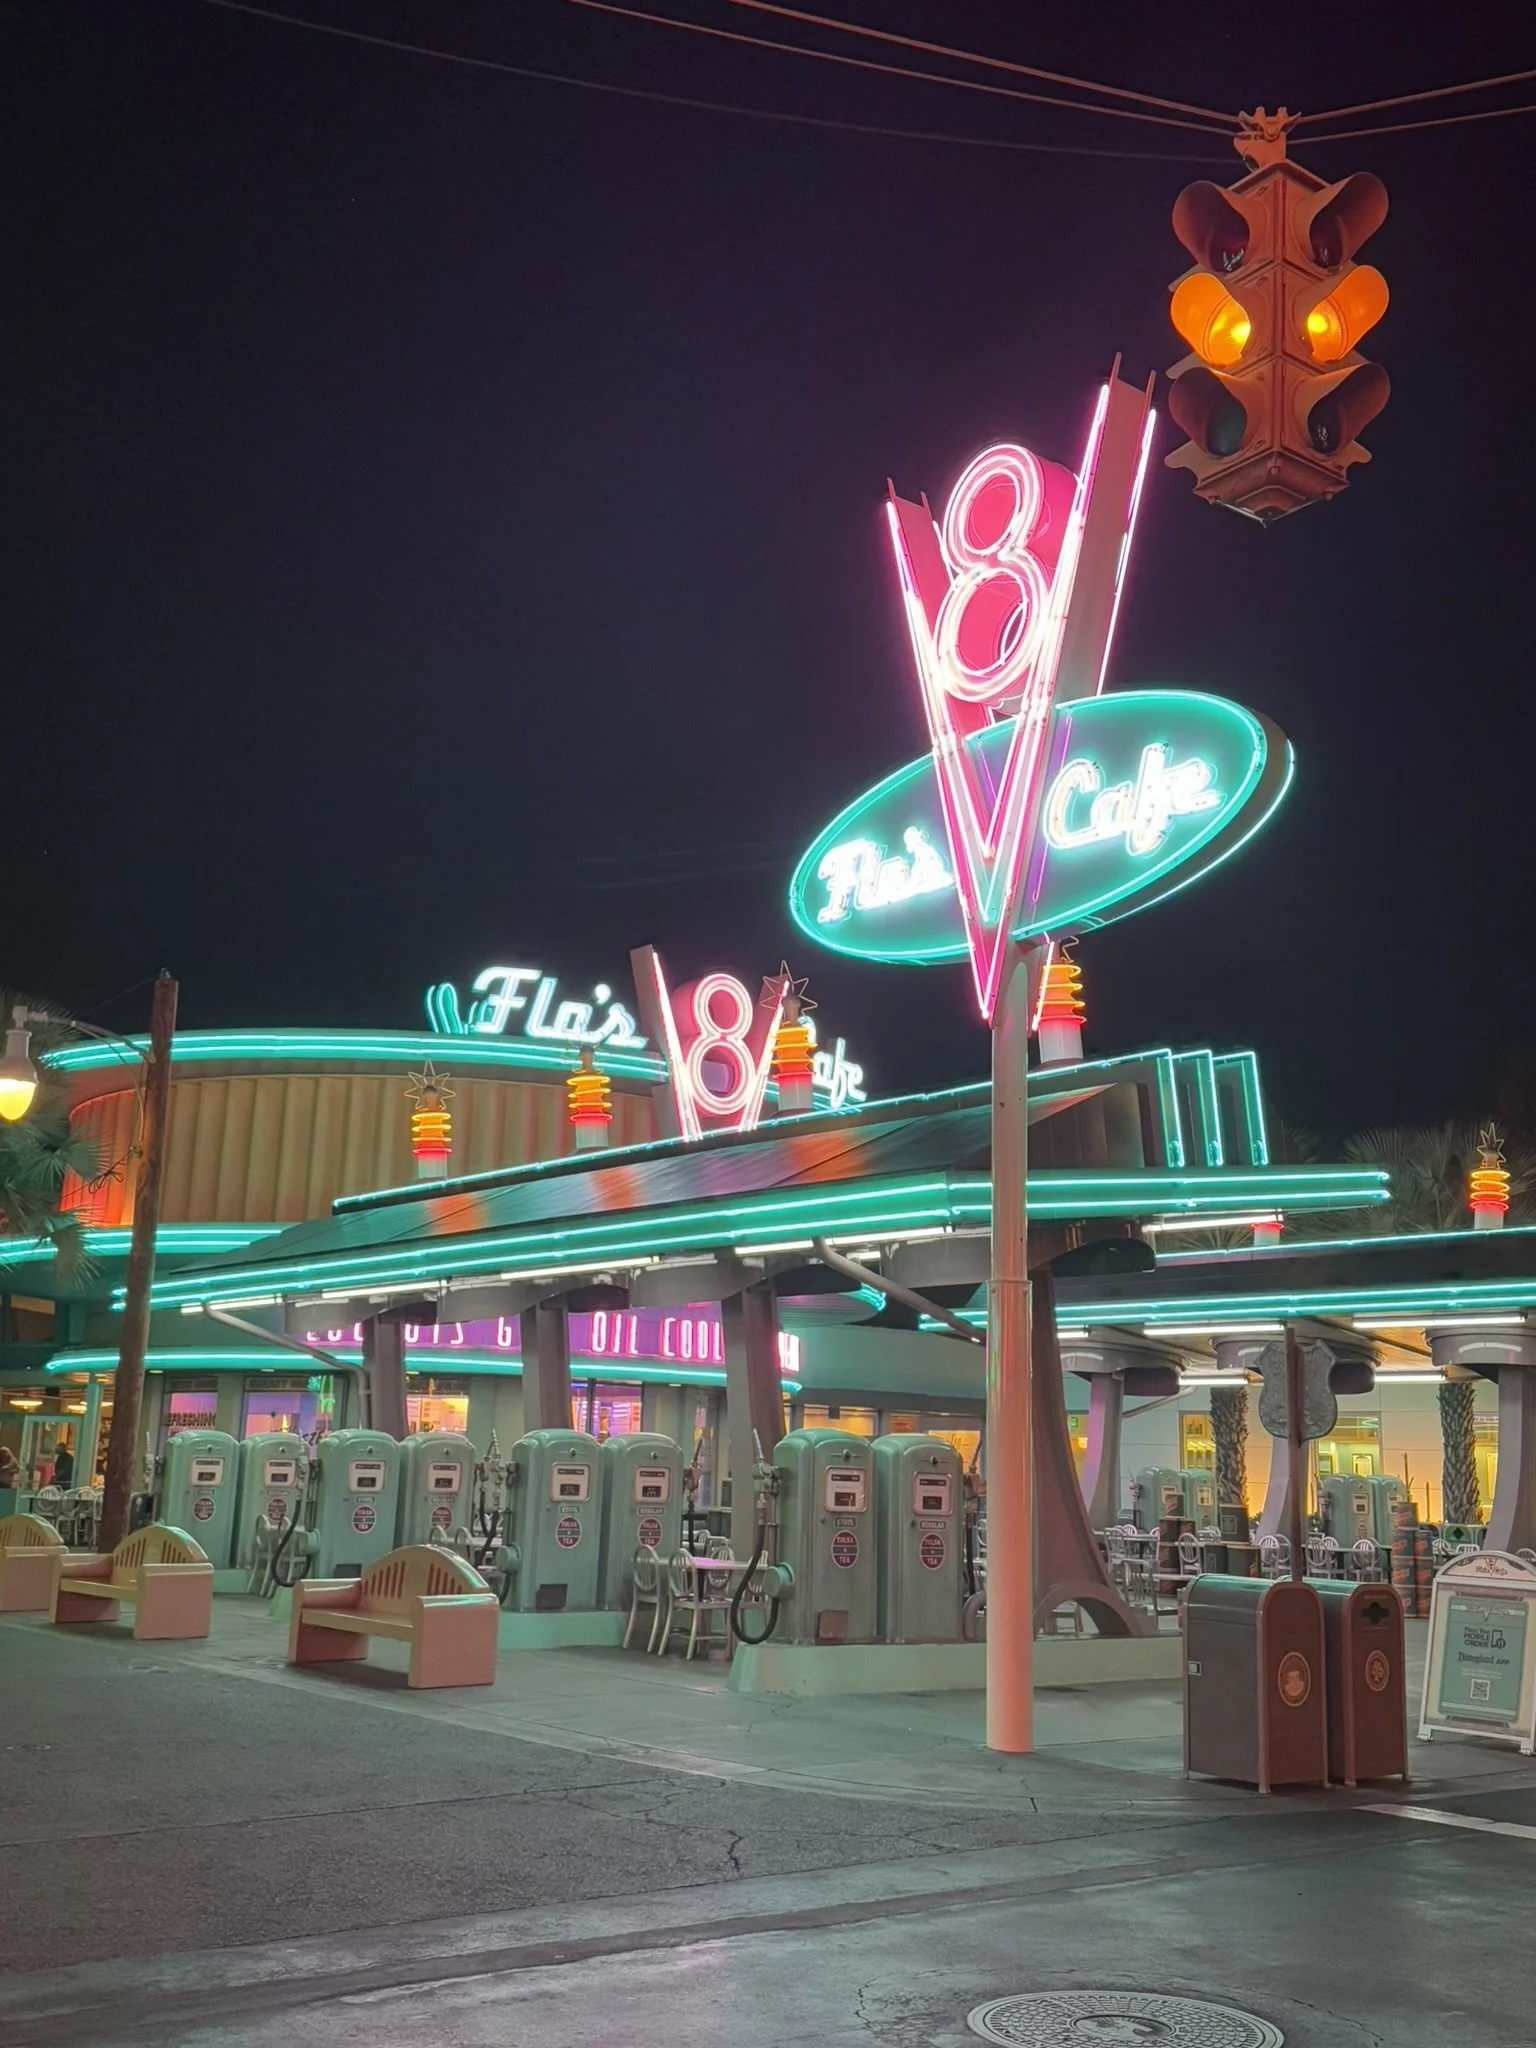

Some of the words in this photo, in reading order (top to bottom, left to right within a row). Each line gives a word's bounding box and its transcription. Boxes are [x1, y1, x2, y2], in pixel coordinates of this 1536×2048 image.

[818, 826, 955, 924] Flo's
[1043, 742, 1226, 857] Cafe
[471, 965, 649, 1049] Flo's
[591, 1311, 638, 1354] OIL
[563, 1537, 574, 1545] TEA
[1463, 1632, 1490, 1642] MOBILE
[1464, 1640, 1489, 1649] ORDER
